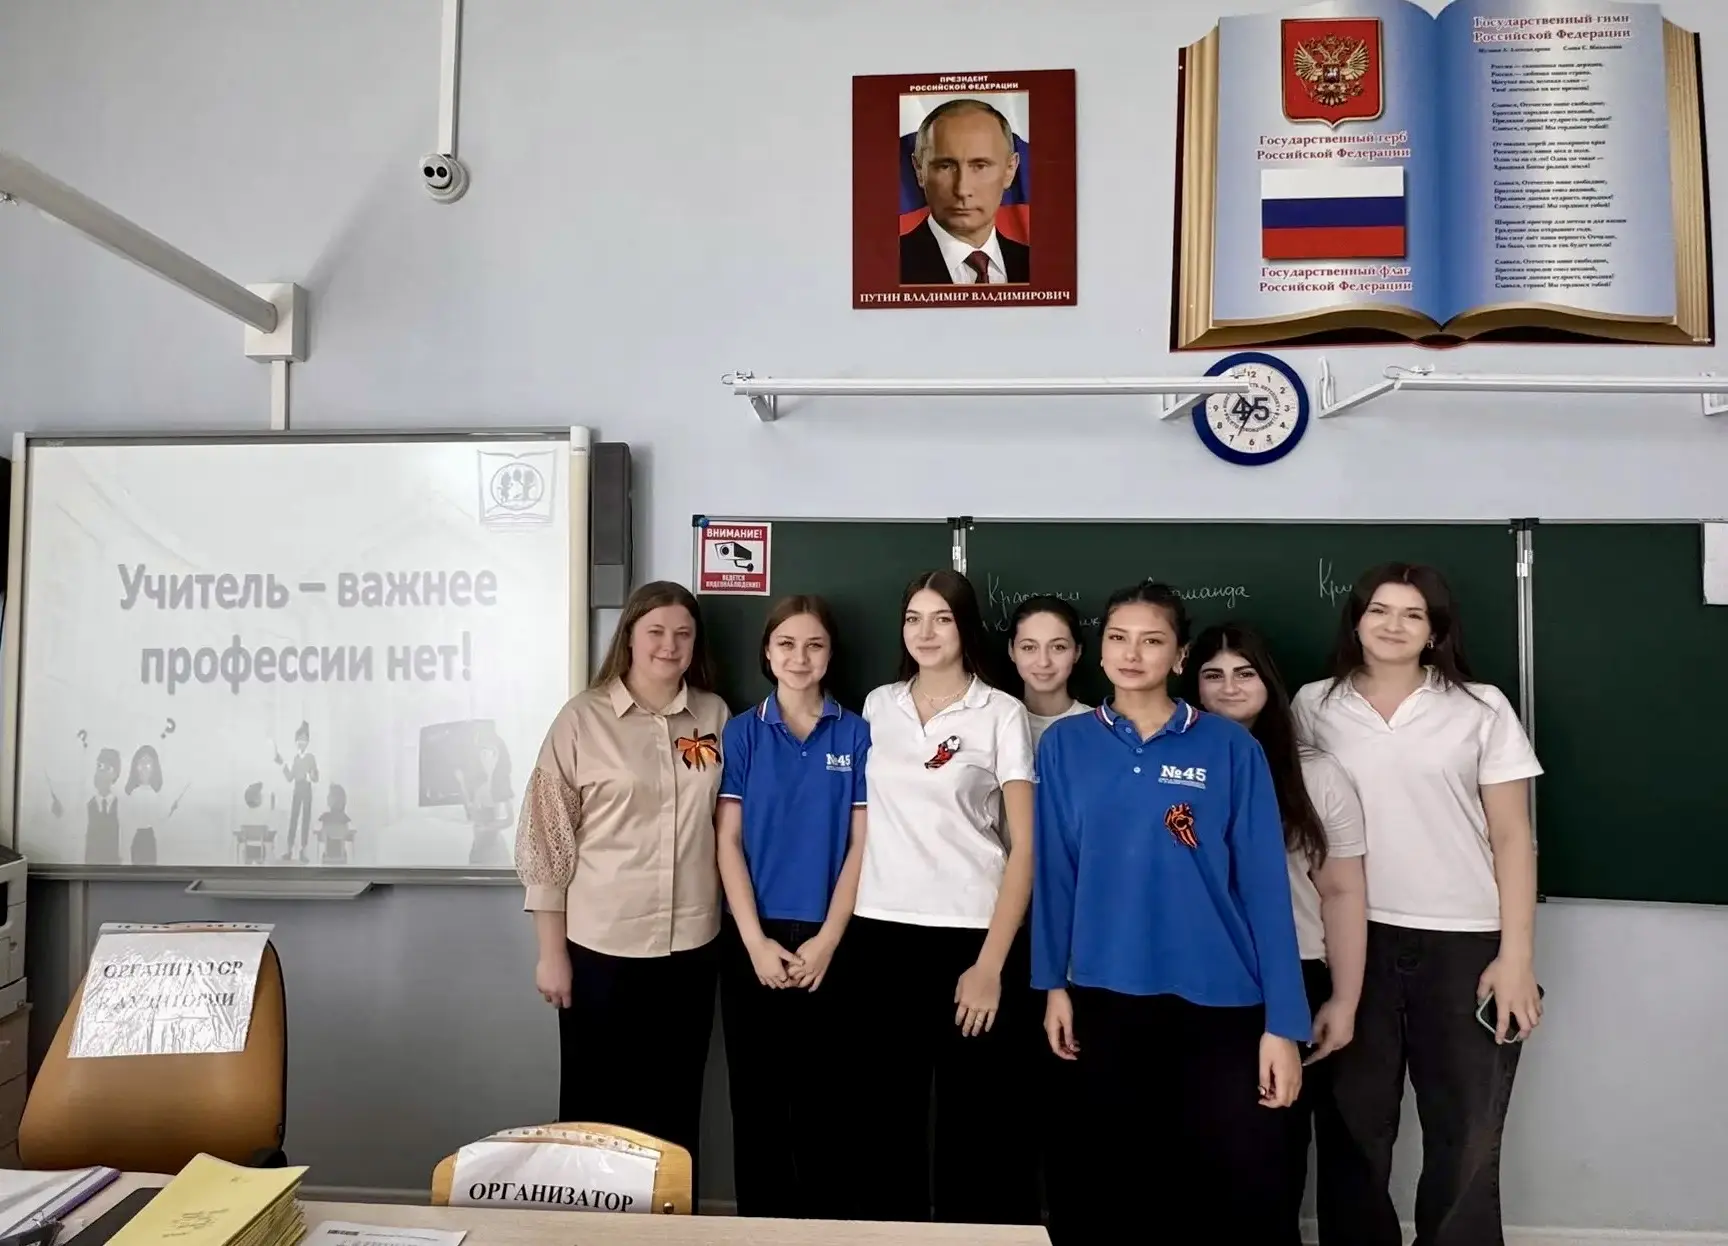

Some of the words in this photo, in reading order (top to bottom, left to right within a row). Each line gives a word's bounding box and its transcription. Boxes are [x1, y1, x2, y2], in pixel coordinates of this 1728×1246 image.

[1475, 15, 1593, 30] Государственный
[1596, 14, 1631, 24] гимн
[1474, 29, 1552, 43] Российской
[1556, 28, 1631, 42] Федерации
[940, 75, 989, 83] ПРЕЗИДЕНТ
[909, 83, 966, 92] РОССИЙСКОЙ
[968, 82, 1019, 91] ФЕДЕРАЦИИ
[1260, 132, 1373, 148] Государственный
[1378, 132, 1407, 146] герб
[1257, 149, 1333, 160] Российской
[1336, 148, 1410, 161] Федерации
[1261, 265, 1375, 280] Государственный
[1379, 265, 1410, 279] флаг
[1260, 280, 1335, 293] Российской
[1338, 280, 1412, 294] Федерации
[860, 293, 900, 303] ПУТИН
[904, 292, 969, 303] ВЛАДИМИР
[972, 291, 1071, 303] ВЛАДИМИРОВИЧ
[1247, 371, 1257, 379] 12
[1280, 387, 1287, 395] 2
[1231, 396, 1271, 421] 45
[1284, 405, 1290, 413] 3
[1217, 421, 1223, 429] 8
[1280, 421, 1286, 429] 4
[1229, 434, 1235, 442] 7
[1249, 438, 1255, 446] 6
[1266, 434, 1272, 443] 5
[706, 528, 763, 539] ВНИМАНИЕ!
[117, 563, 290, 611] Учитель
[337, 569, 499, 608] важнее
[140, 634, 373, 695] профессии
[387, 630, 472, 682] нет!
[826, 753, 851, 767] №45
[1161, 764, 1207, 782] №45
[469, 1182, 634, 1213] ОРГАНИЗАТОР
